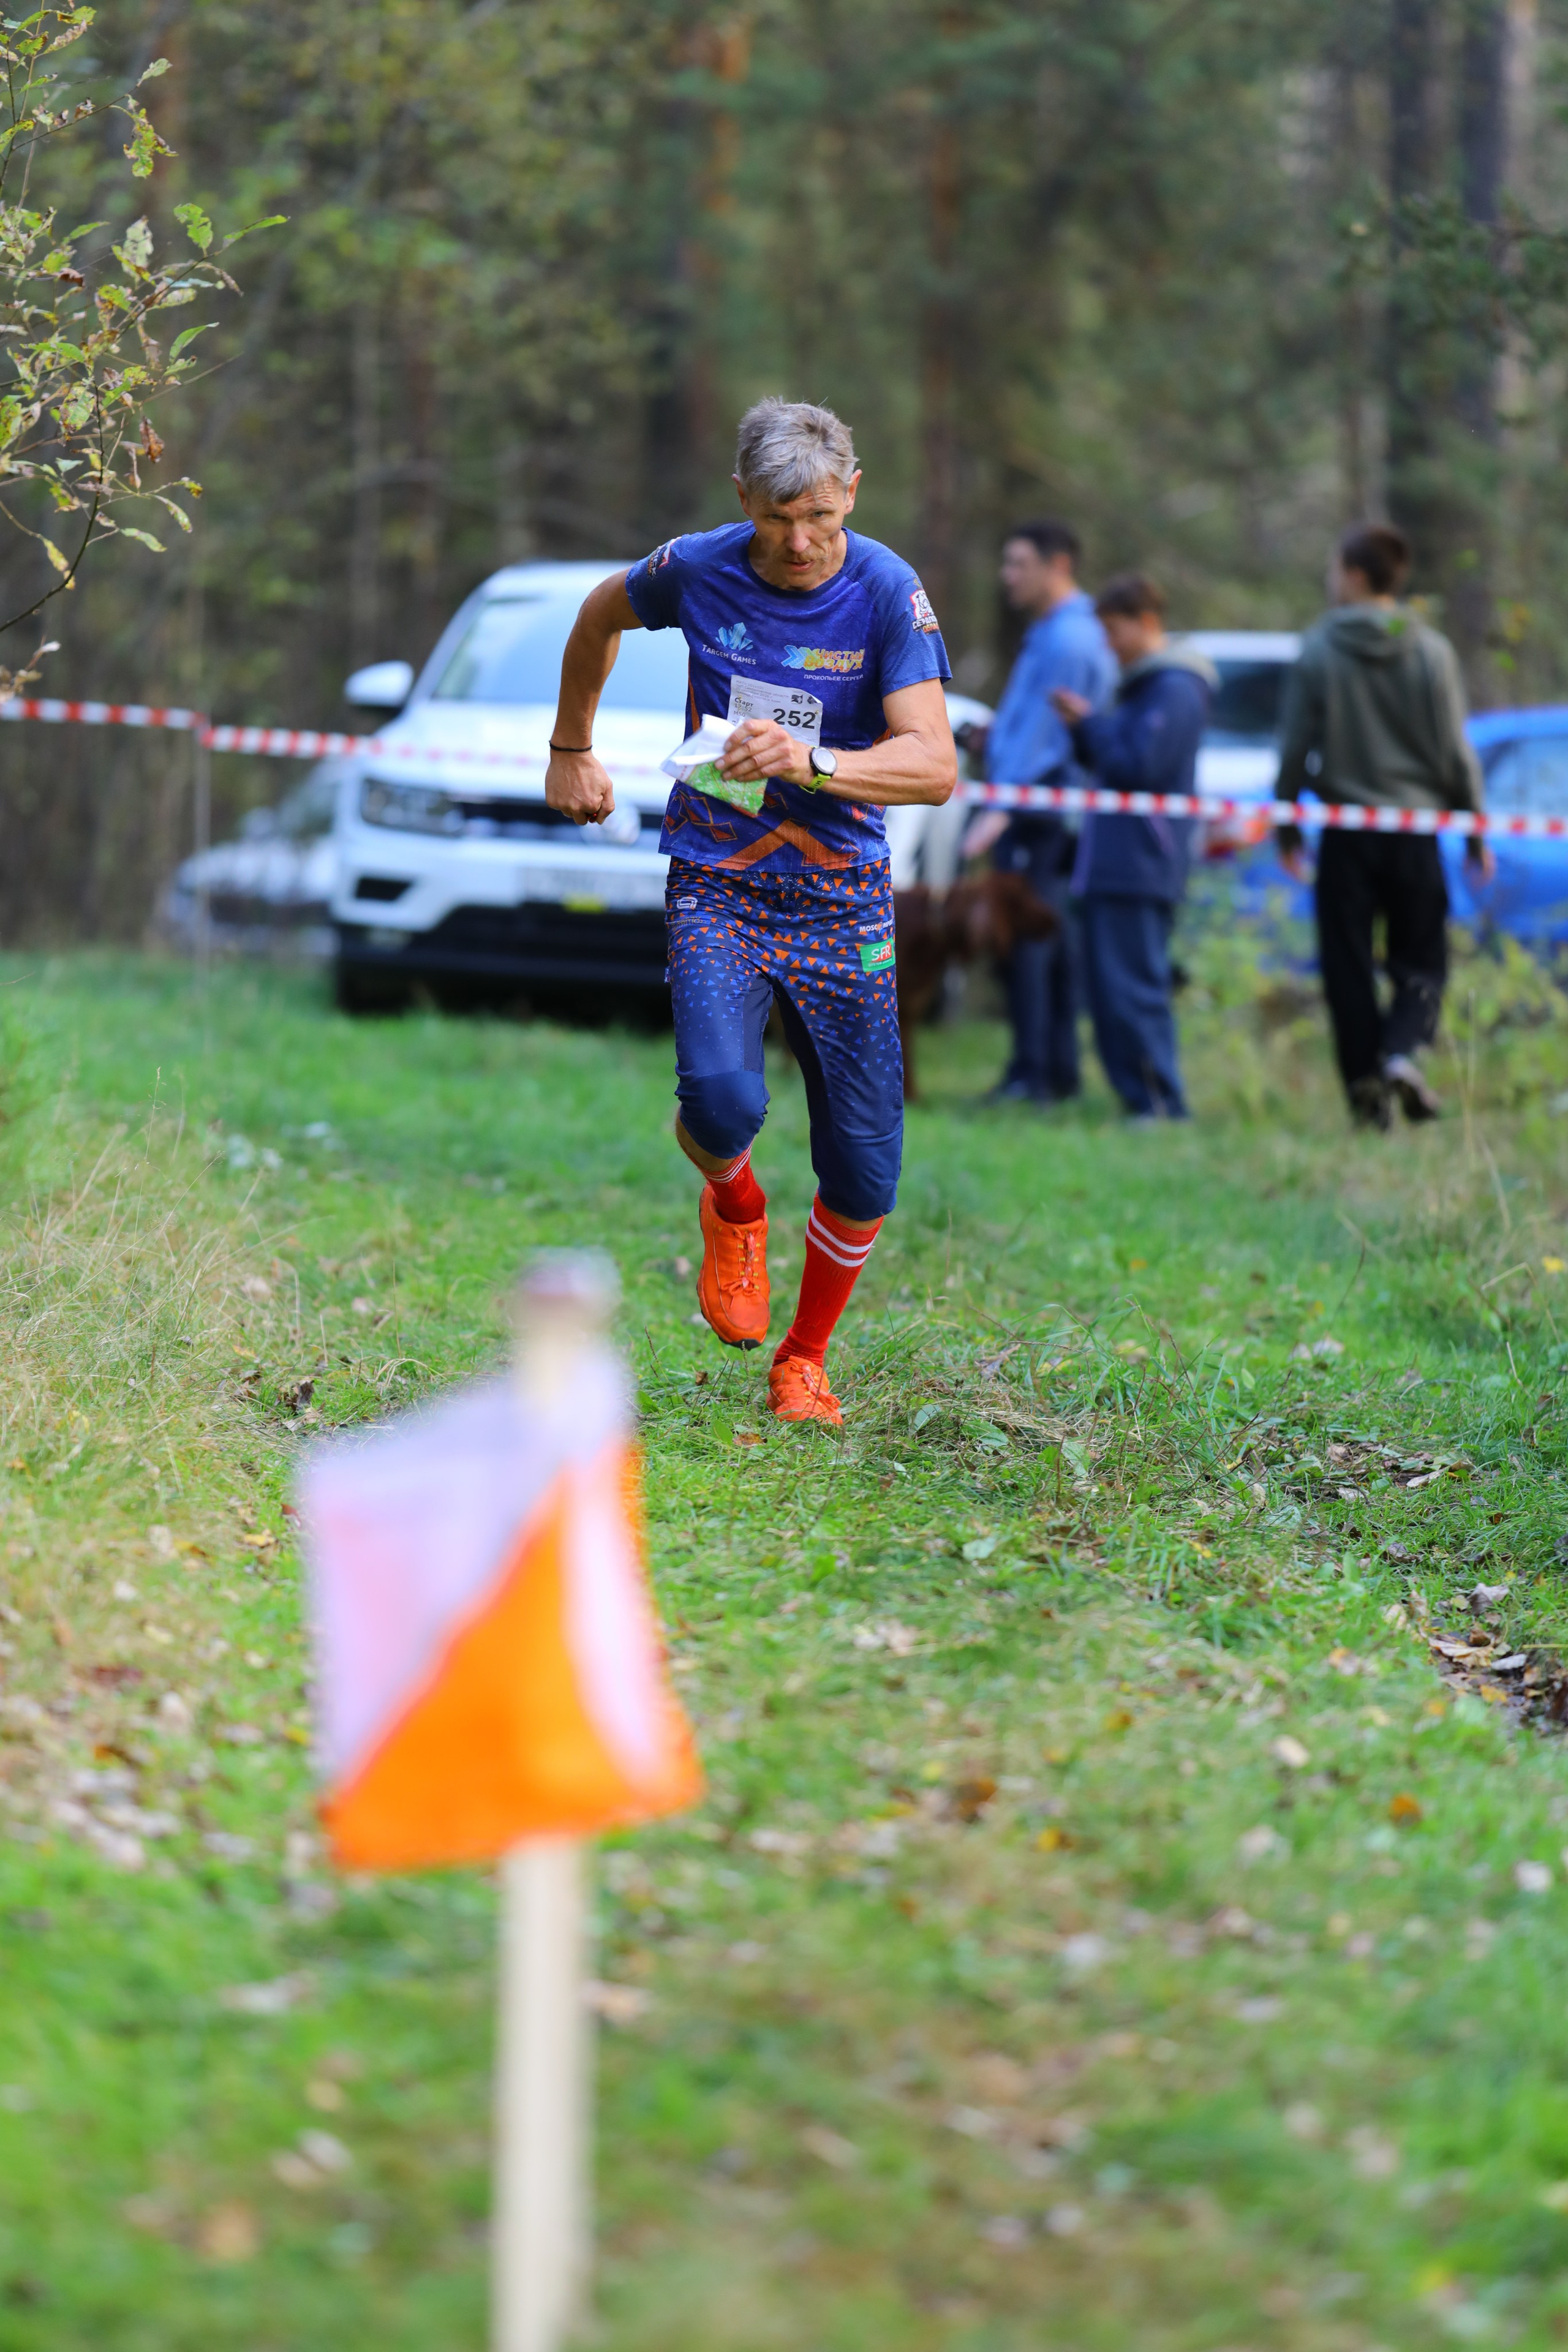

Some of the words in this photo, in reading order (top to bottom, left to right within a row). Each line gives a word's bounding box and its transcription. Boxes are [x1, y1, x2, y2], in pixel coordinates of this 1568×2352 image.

[702, 644, 729, 658] TARGEM
[731, 654, 756, 665] GAMES
[734, 697, 753, 707] Старт
[772, 708, 816, 729] 252
[871, 944, 891, 961] SFR
